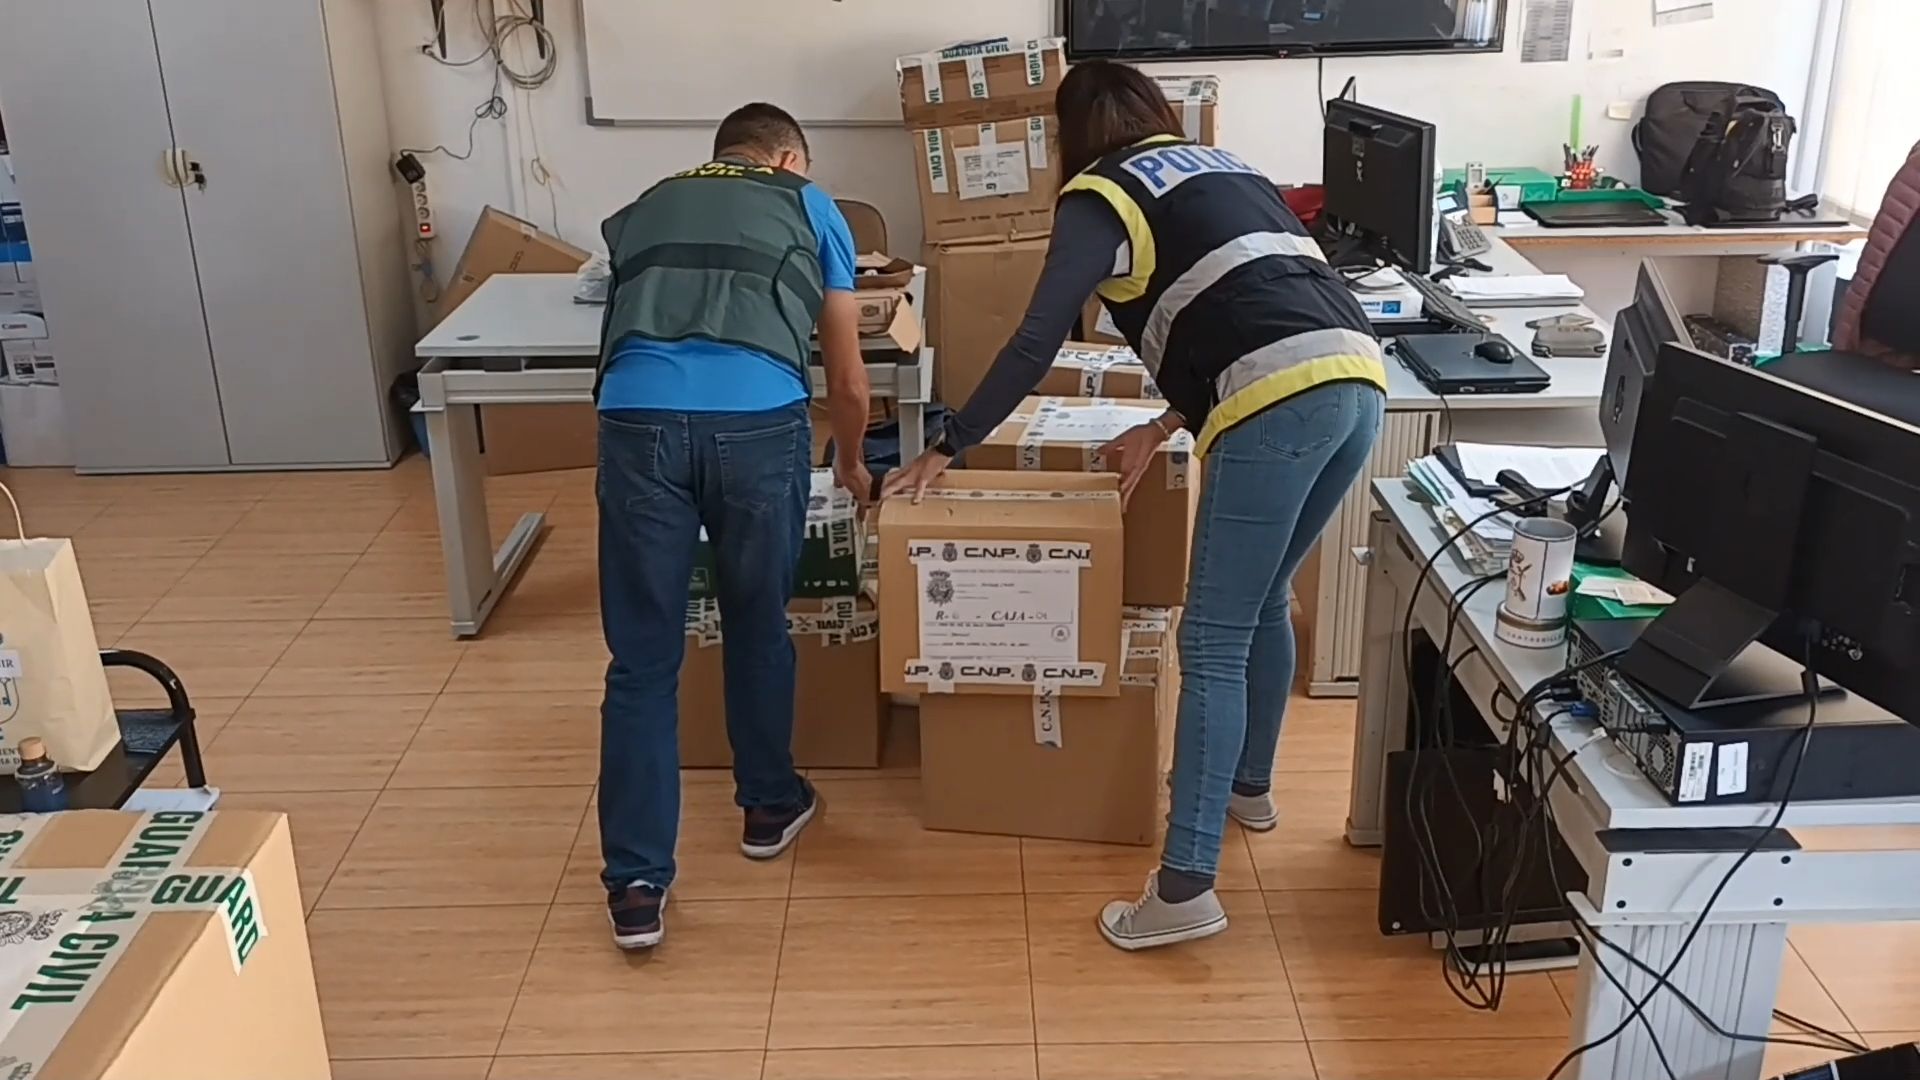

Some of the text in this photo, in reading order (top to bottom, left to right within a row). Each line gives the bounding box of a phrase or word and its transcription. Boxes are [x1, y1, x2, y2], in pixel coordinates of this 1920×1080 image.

[964, 548, 1020, 558] C.N.P.
[960, 666, 1015, 677] C.N.P.
[1043, 668, 1098, 679] C.N.P.
[10, 933, 119, 1010] CIVIL
